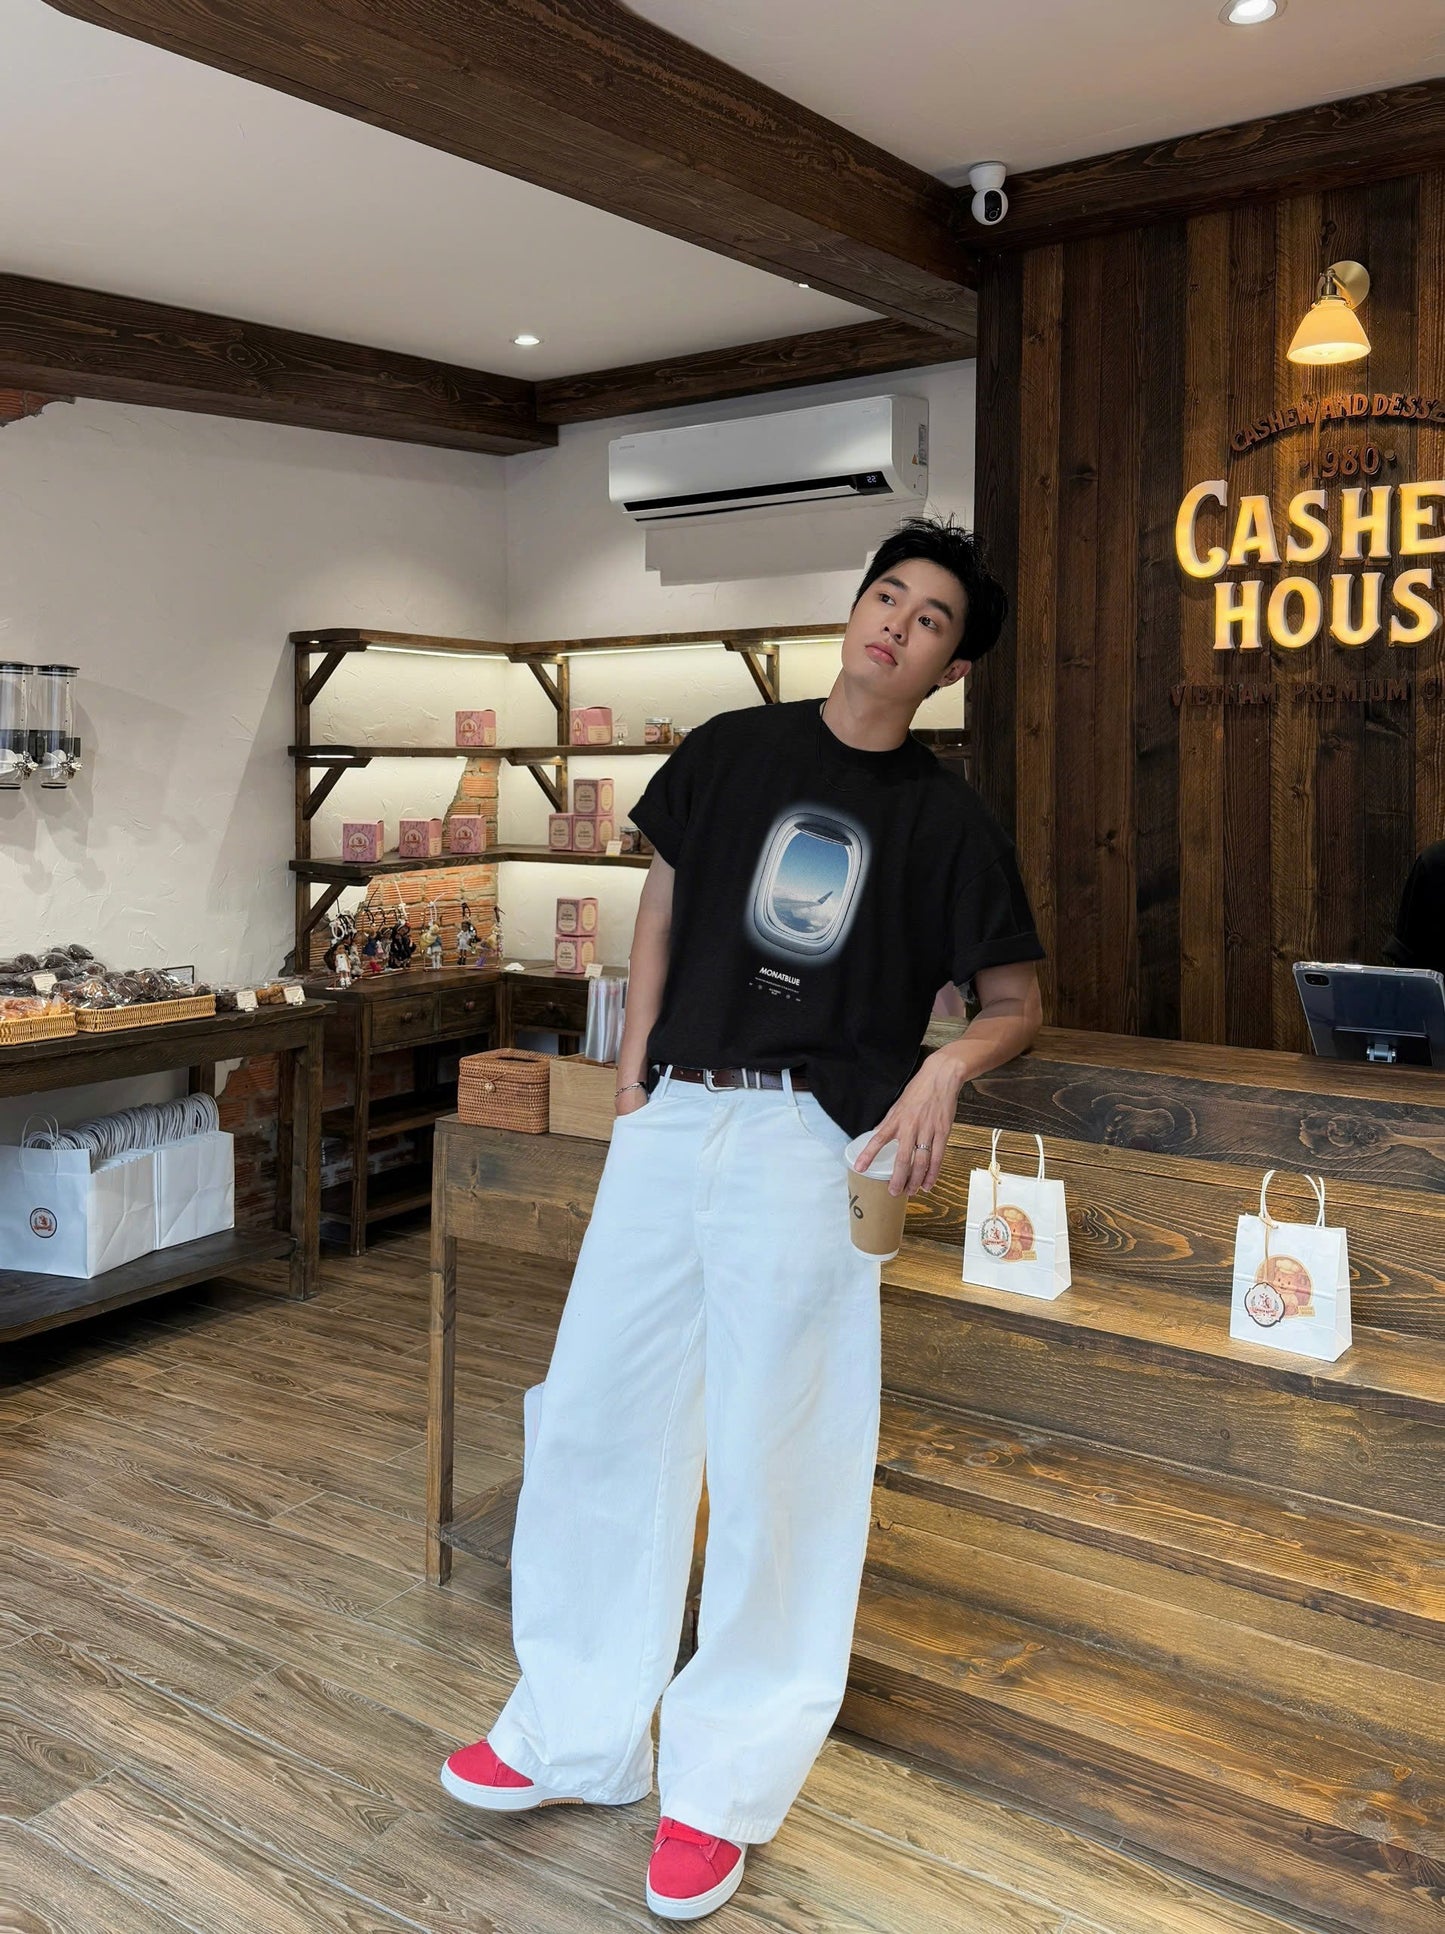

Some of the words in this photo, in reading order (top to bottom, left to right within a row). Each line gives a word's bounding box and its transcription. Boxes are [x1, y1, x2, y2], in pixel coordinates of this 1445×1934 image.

[1231, 400, 1319, 452] CASHEW
[1321, 393, 1367, 420] AND
[1175, 479, 1445, 579] CASHE
[1213, 568, 1440, 650] HOUS
[1292, 678, 1408, 703] PREMIUM
